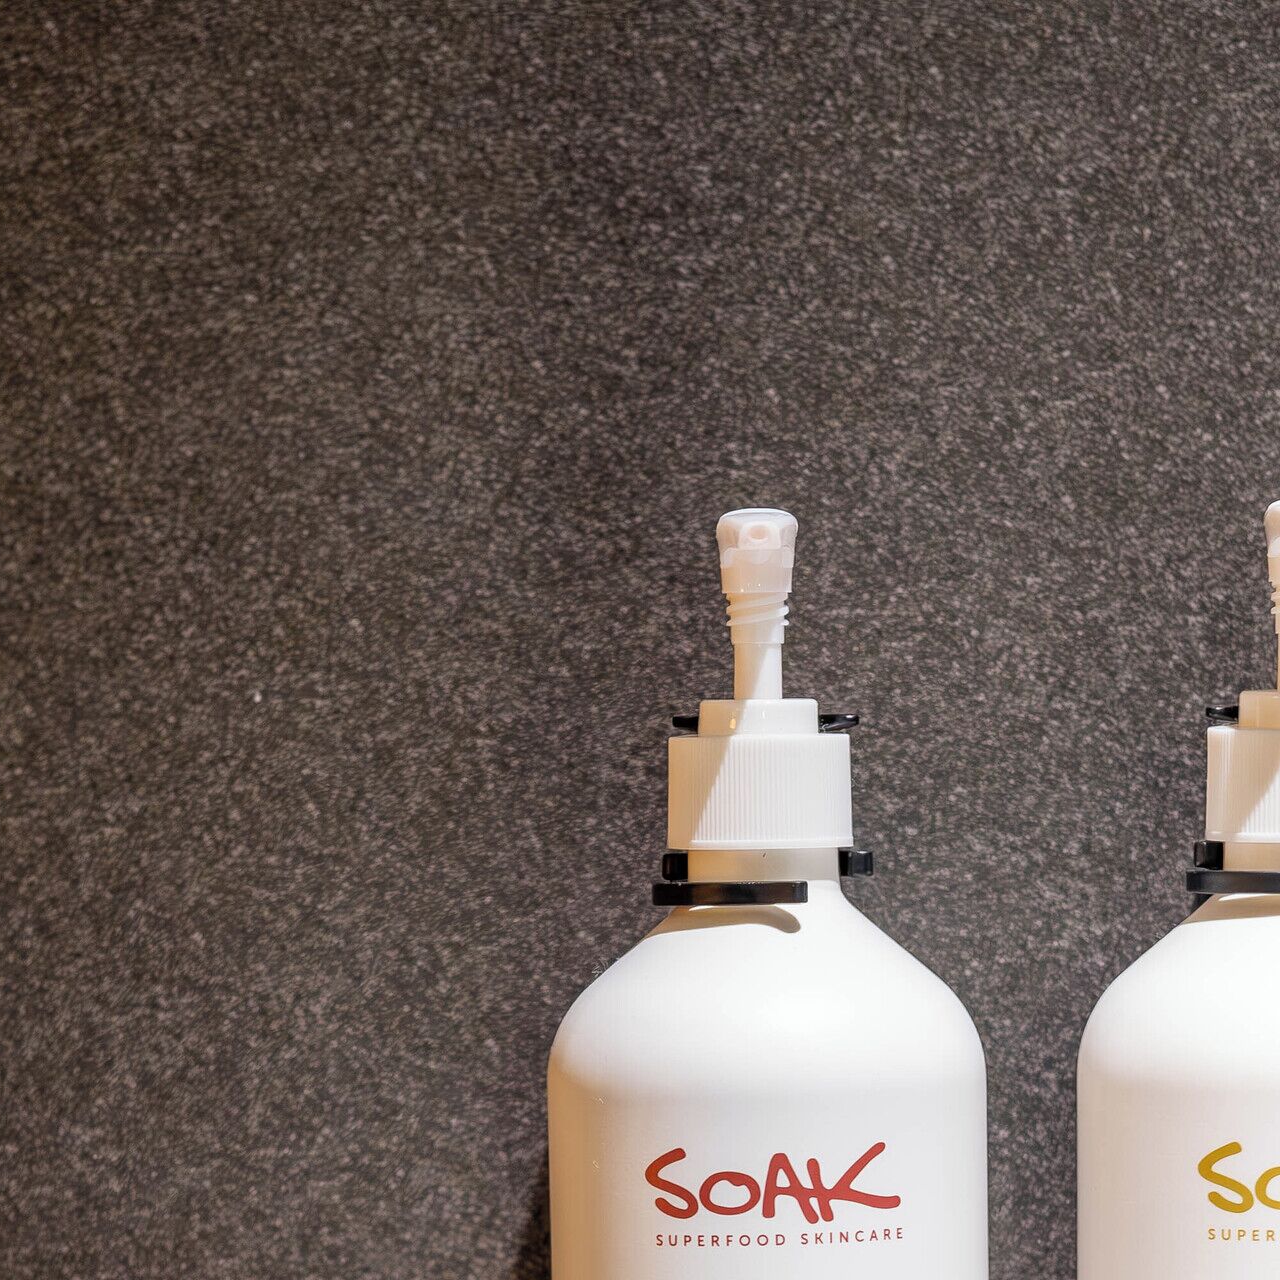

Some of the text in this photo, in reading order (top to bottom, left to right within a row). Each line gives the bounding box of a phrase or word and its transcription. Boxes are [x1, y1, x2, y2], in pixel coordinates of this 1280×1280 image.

[645, 1142, 901, 1224] SOAK
[656, 1228, 904, 1247] SUPERFOOD SKINCARE
